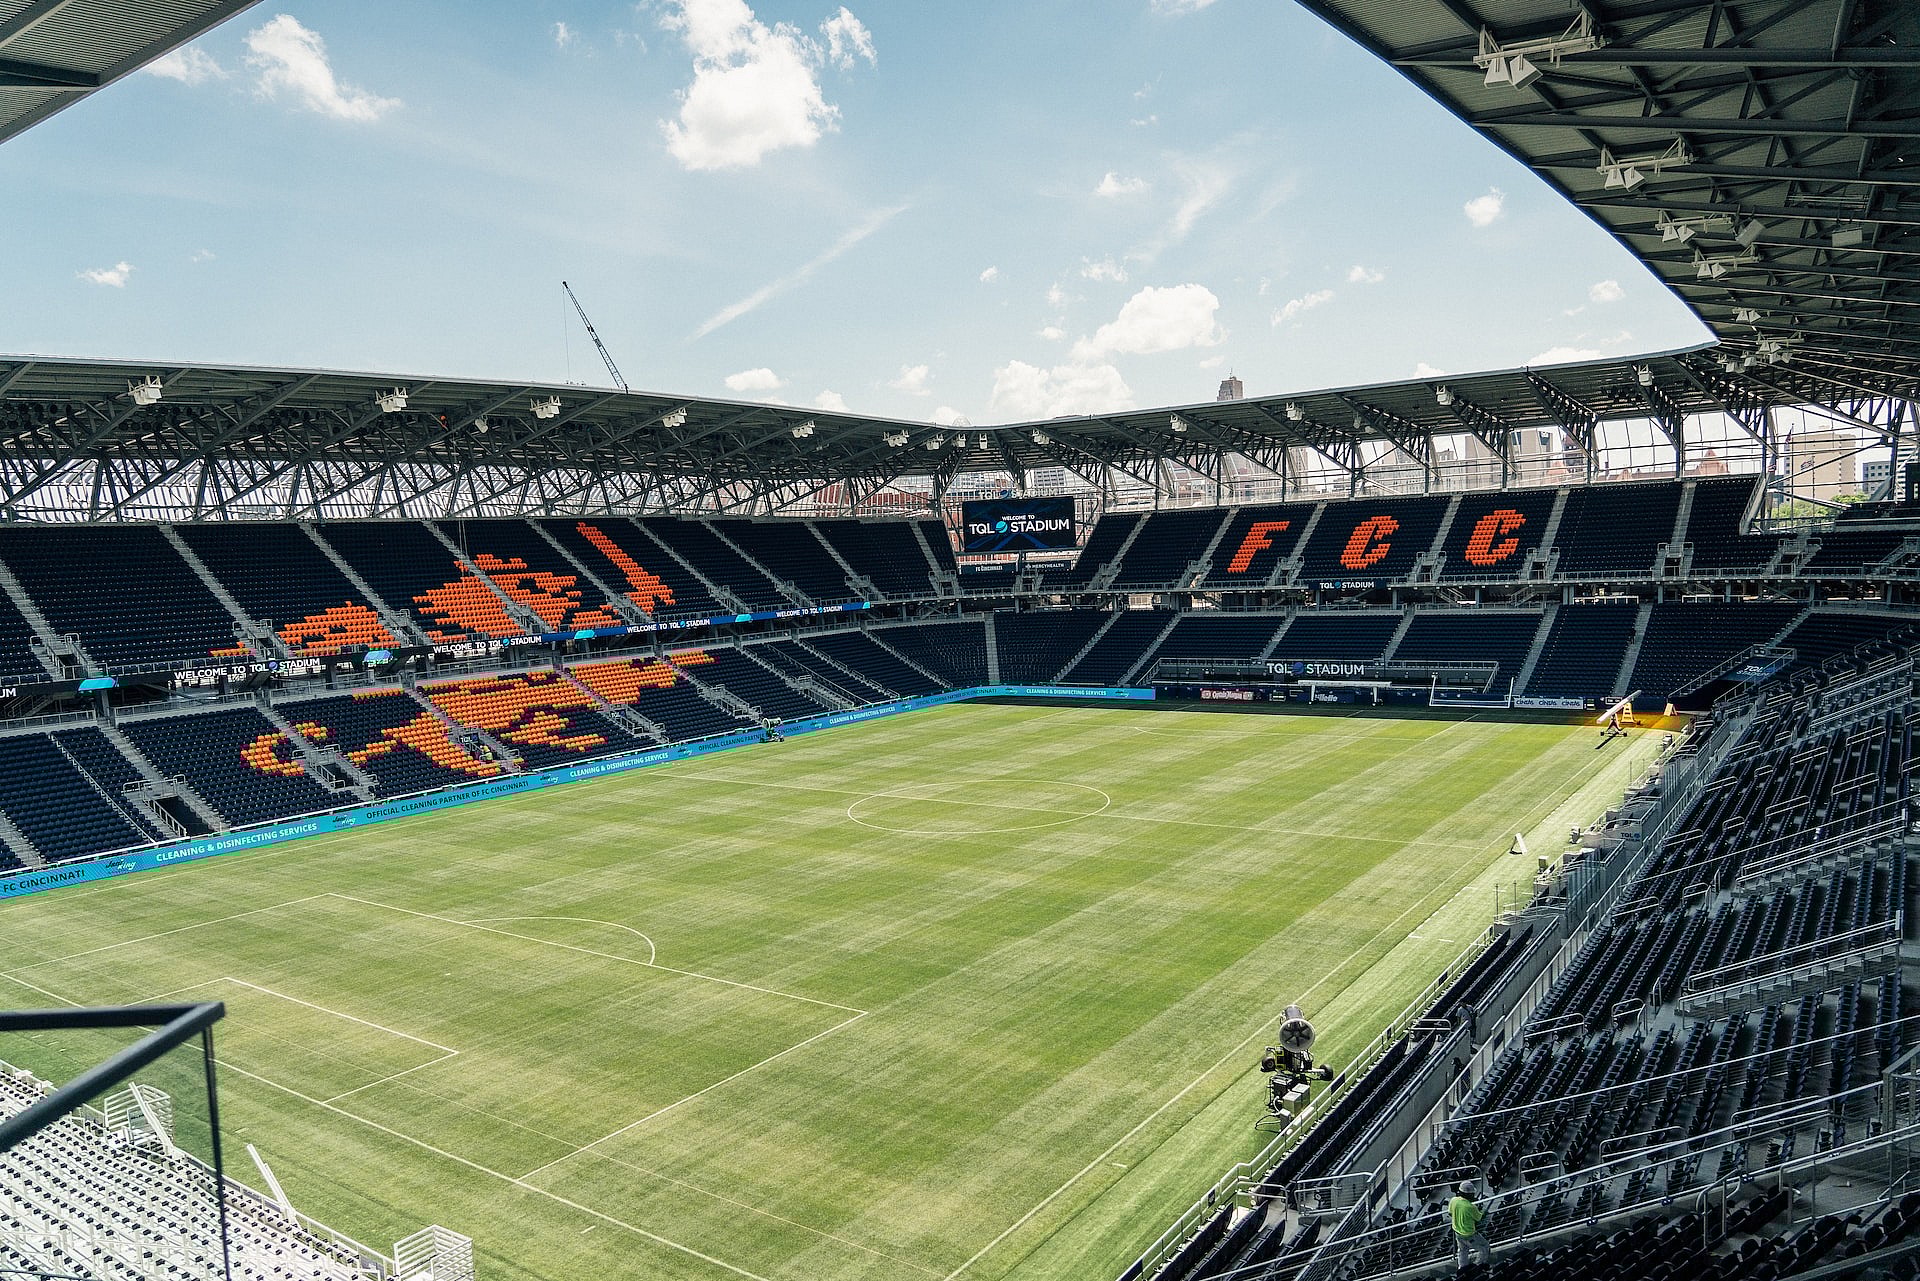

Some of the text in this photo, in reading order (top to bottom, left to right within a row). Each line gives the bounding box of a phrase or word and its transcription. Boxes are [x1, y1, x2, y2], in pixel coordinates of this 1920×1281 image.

[969, 519, 1070, 535] TQL STADIUM
[776, 609, 800, 618] WELCOME
[627, 624, 657, 634] WELCOME
[686, 618, 710, 627] STADIUM
[433, 642, 473, 653] WELCOME
[475, 641, 486, 649] TO
[510, 636, 542, 646] STADIUM
[174, 658, 321, 680] WELCOME TO TQL STADIUM
[1266, 663, 1365, 675] TQL STADIUM
[829, 716, 850, 725] CLEANING
[698, 743, 720, 751] OFFICIAL
[720, 738, 744, 747] CLEANING
[570, 767, 600, 778] CLEANING
[606, 758, 645, 770] DISINFECTING
[645, 752, 669, 763] SERVICES
[366, 780, 529, 819] OFFICIAL CLEANING PARTNER OF FC CINCINNATI
[156, 822, 317, 862] CLEANING & DISINFECTING SERVICES
[3, 869, 85, 893] FC CINCINNATI
